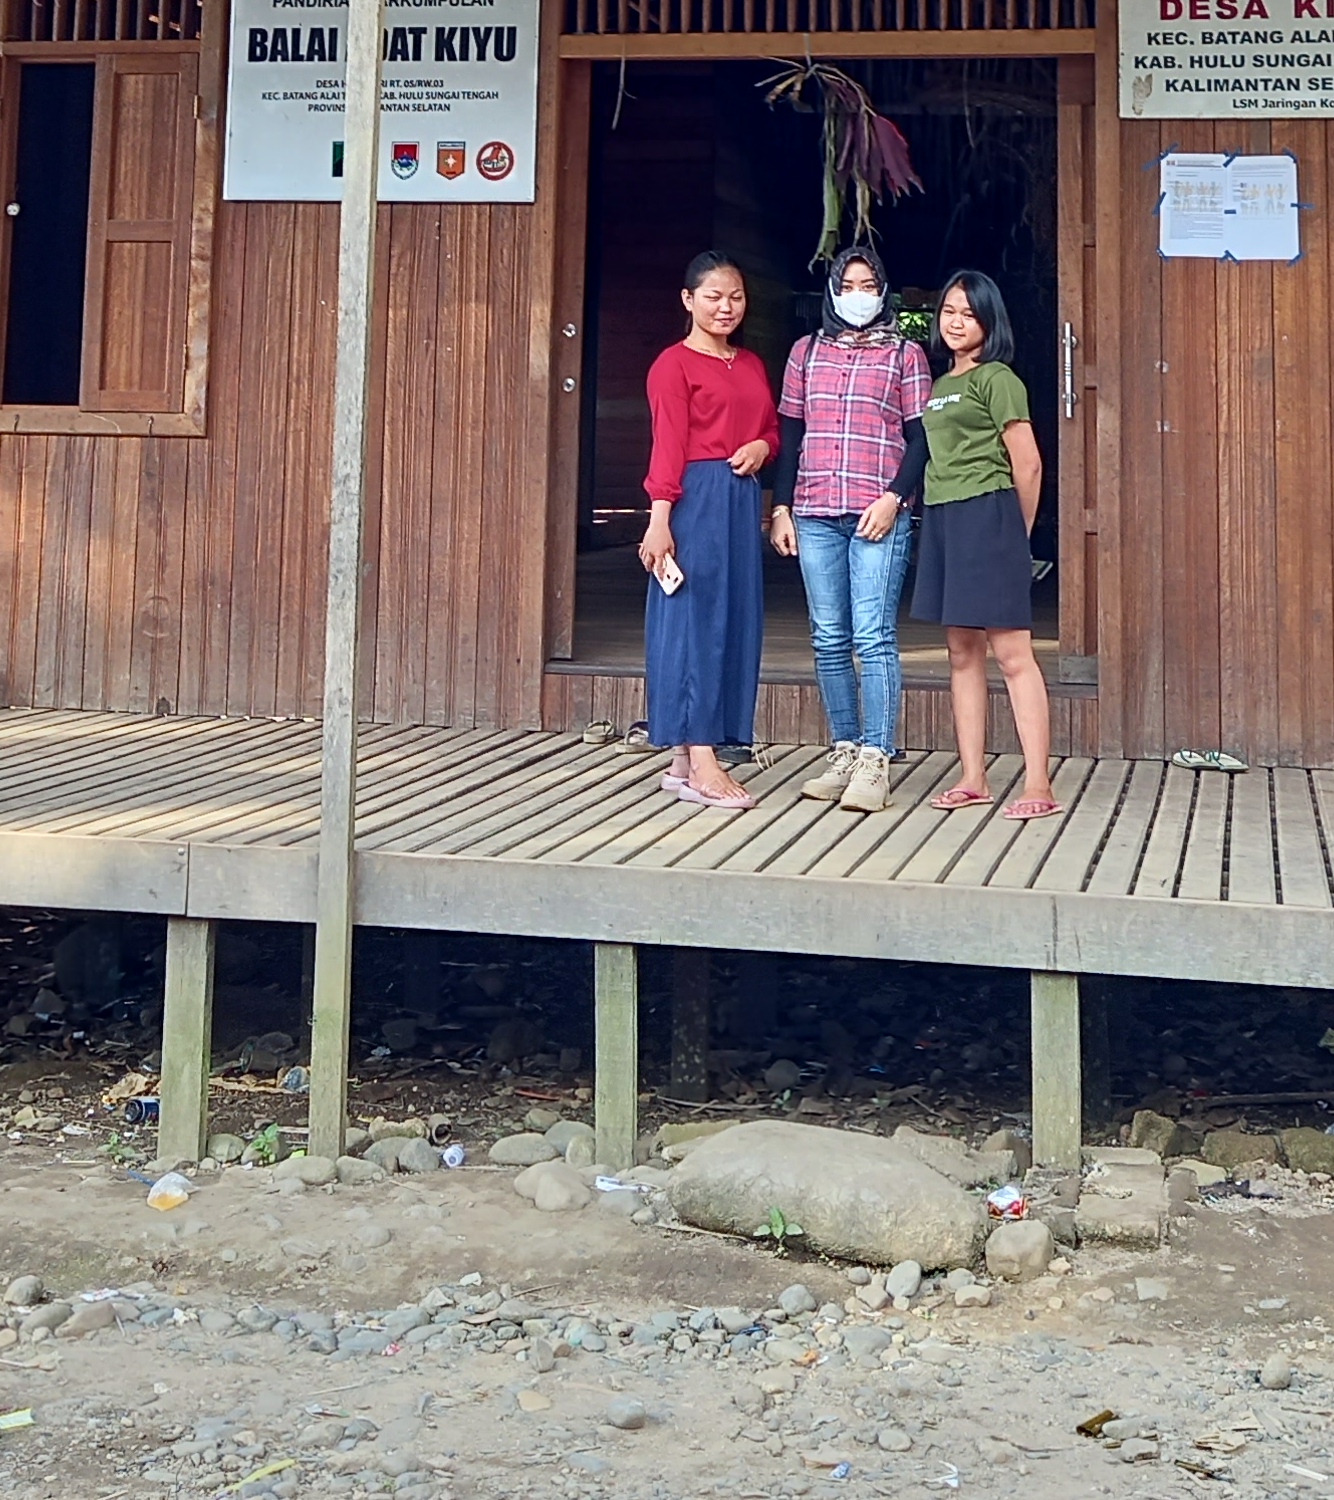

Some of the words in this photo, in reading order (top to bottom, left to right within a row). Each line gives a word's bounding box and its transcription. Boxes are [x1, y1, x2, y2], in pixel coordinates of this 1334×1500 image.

[248, 27, 338, 62] BALAI
[434, 26, 517, 62] KIYU
[1147, 32, 1195, 46] KEC.
[1201, 30, 1284, 45] BATANG
[1134, 55, 1183, 69] KAB.
[1189, 54, 1246, 69] HULU
[1252, 53, 1332, 67] SUNGAI
[316, 80, 339, 89] DESA
[390, 80, 402, 88] RT.
[1165, 77, 1301, 93] KALIMANTAN
[262, 92, 280, 101] KEC.
[283, 92, 318, 101] BATANG
[320, 92, 340, 100] ALAI
[399, 92, 423, 100] HULU
[425, 92, 460, 100] SUNGAI
[462, 91, 499, 100] TENGAH
[412, 103, 450, 112] SELATAN
[1232, 99, 1258, 109] LSM
[1261, 98, 1316, 112] Jaringan
